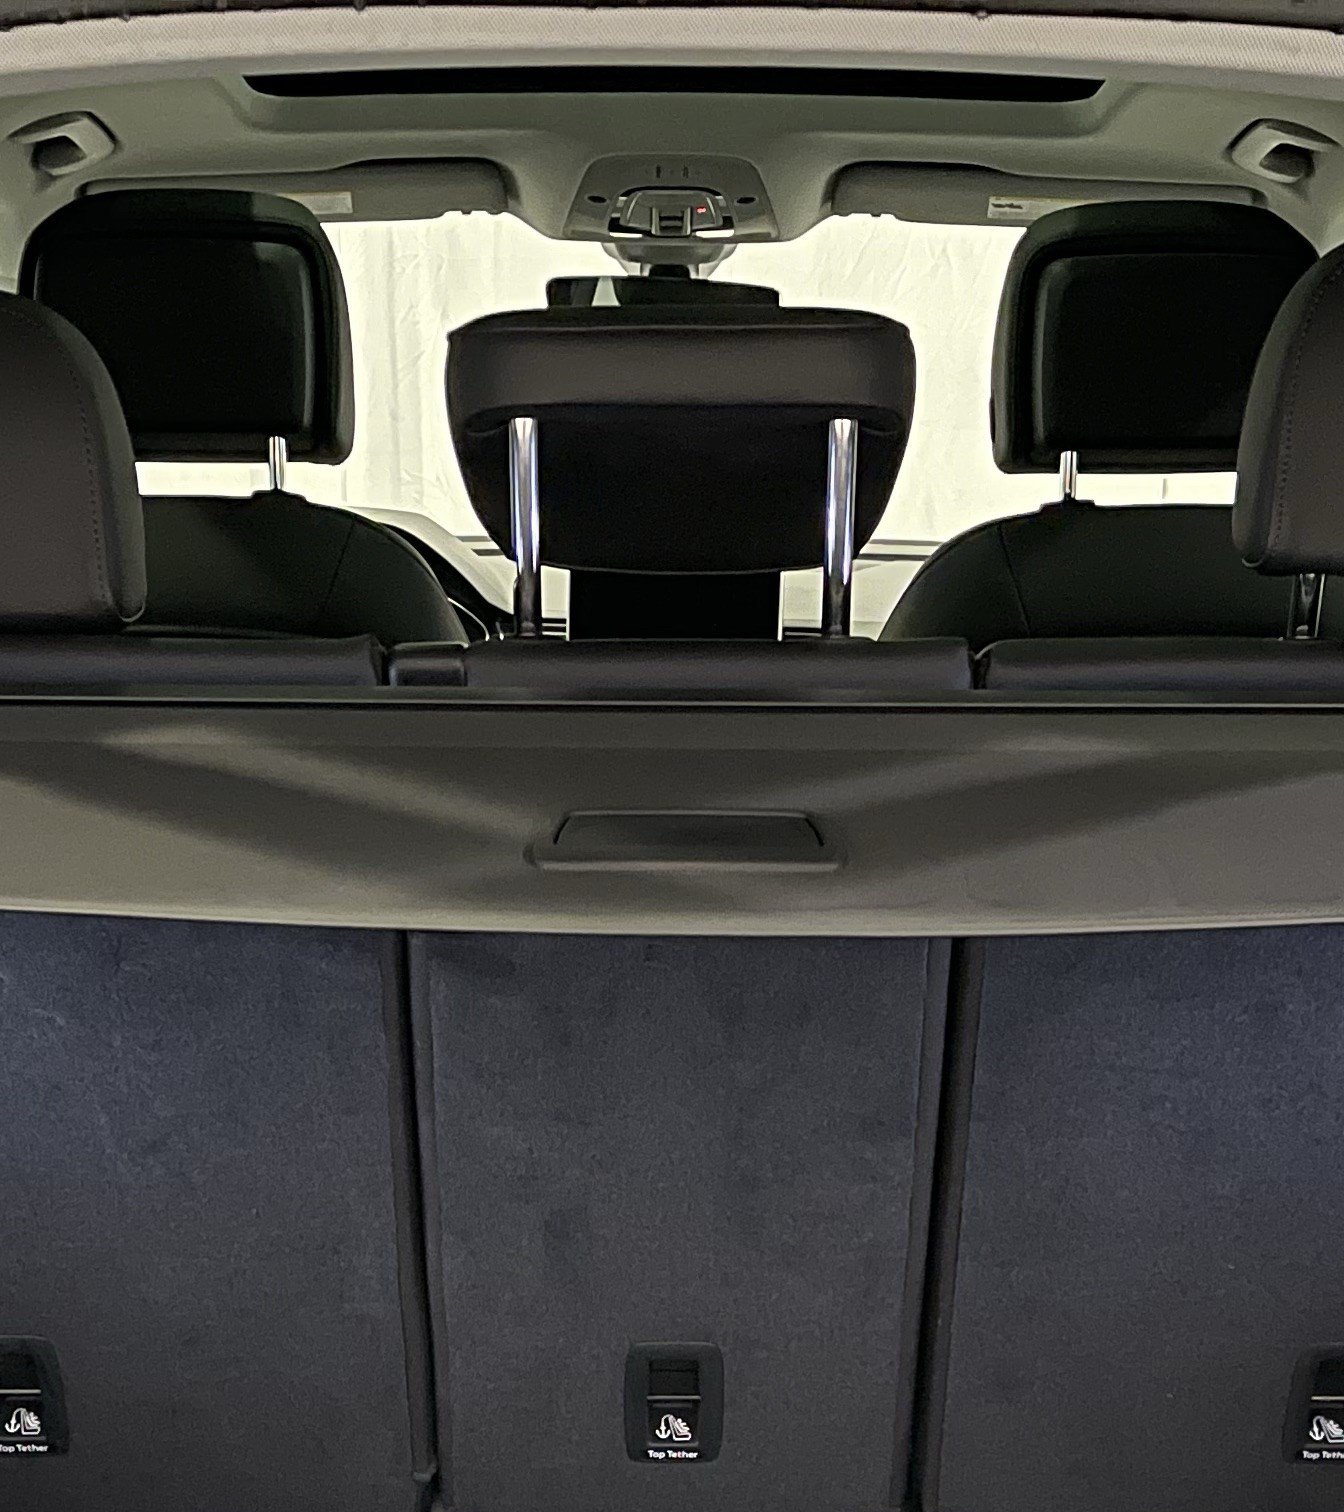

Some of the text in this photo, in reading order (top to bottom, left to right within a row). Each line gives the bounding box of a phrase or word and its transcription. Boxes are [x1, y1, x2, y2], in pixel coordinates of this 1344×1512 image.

[16, 1444, 48, 1452] Tether
[647, 1450, 698, 1459] Top Tether
[1302, 1450, 1320, 1460] Top
